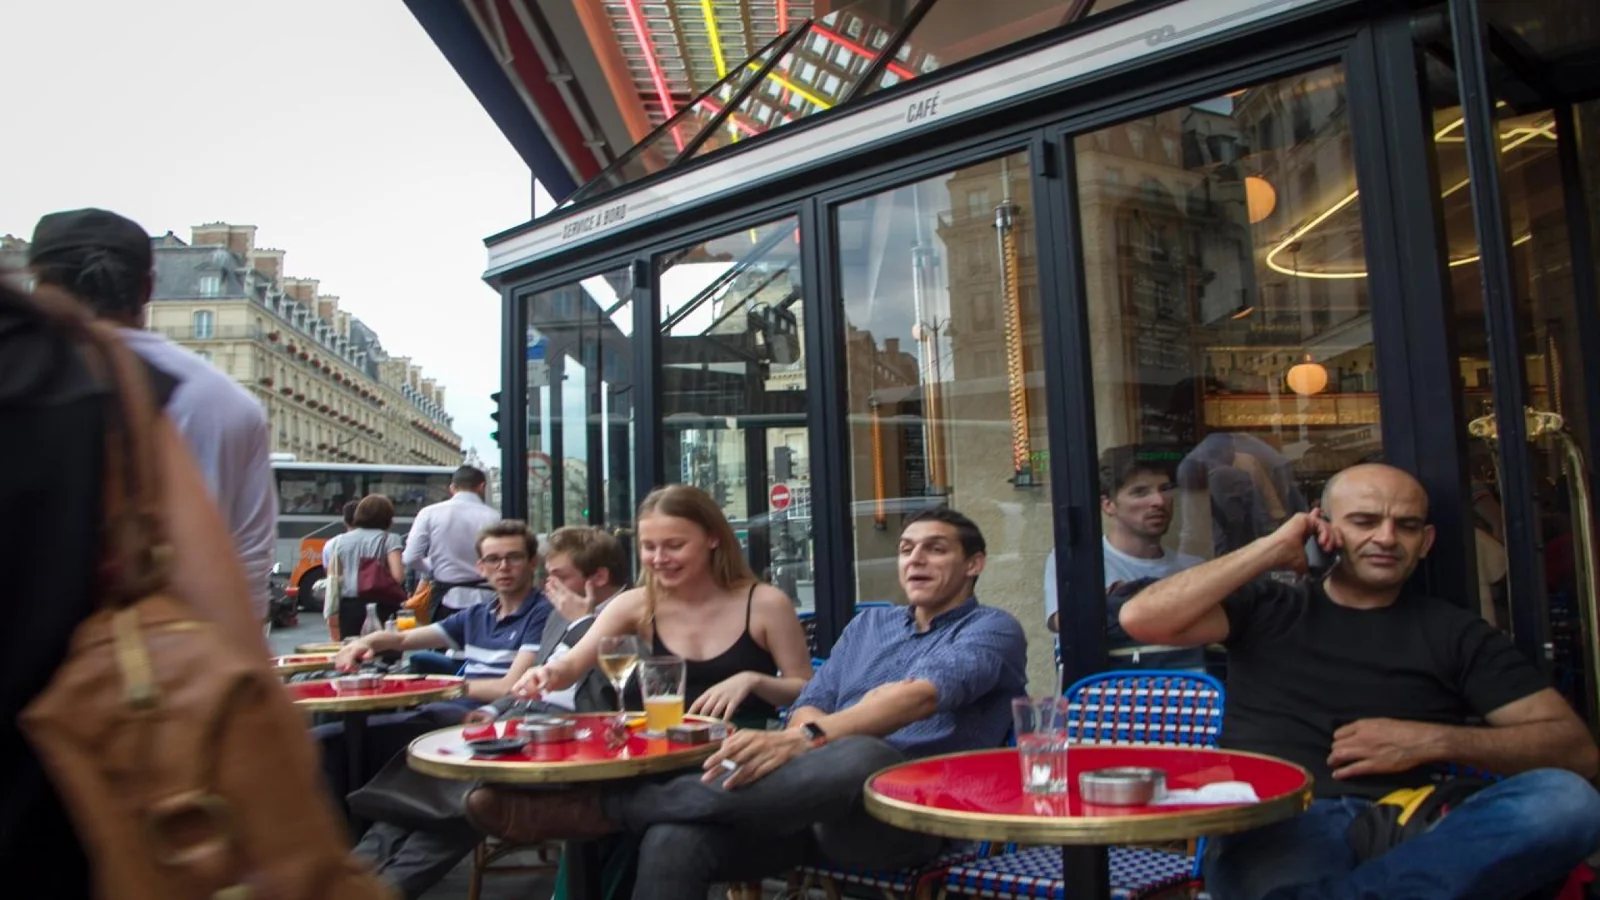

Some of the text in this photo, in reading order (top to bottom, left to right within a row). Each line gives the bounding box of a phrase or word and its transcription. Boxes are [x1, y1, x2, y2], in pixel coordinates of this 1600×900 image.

[907, 90, 941, 123] CAFÉ
[562, 215, 595, 239] SERVICE
[603, 204, 627, 226] BORD
